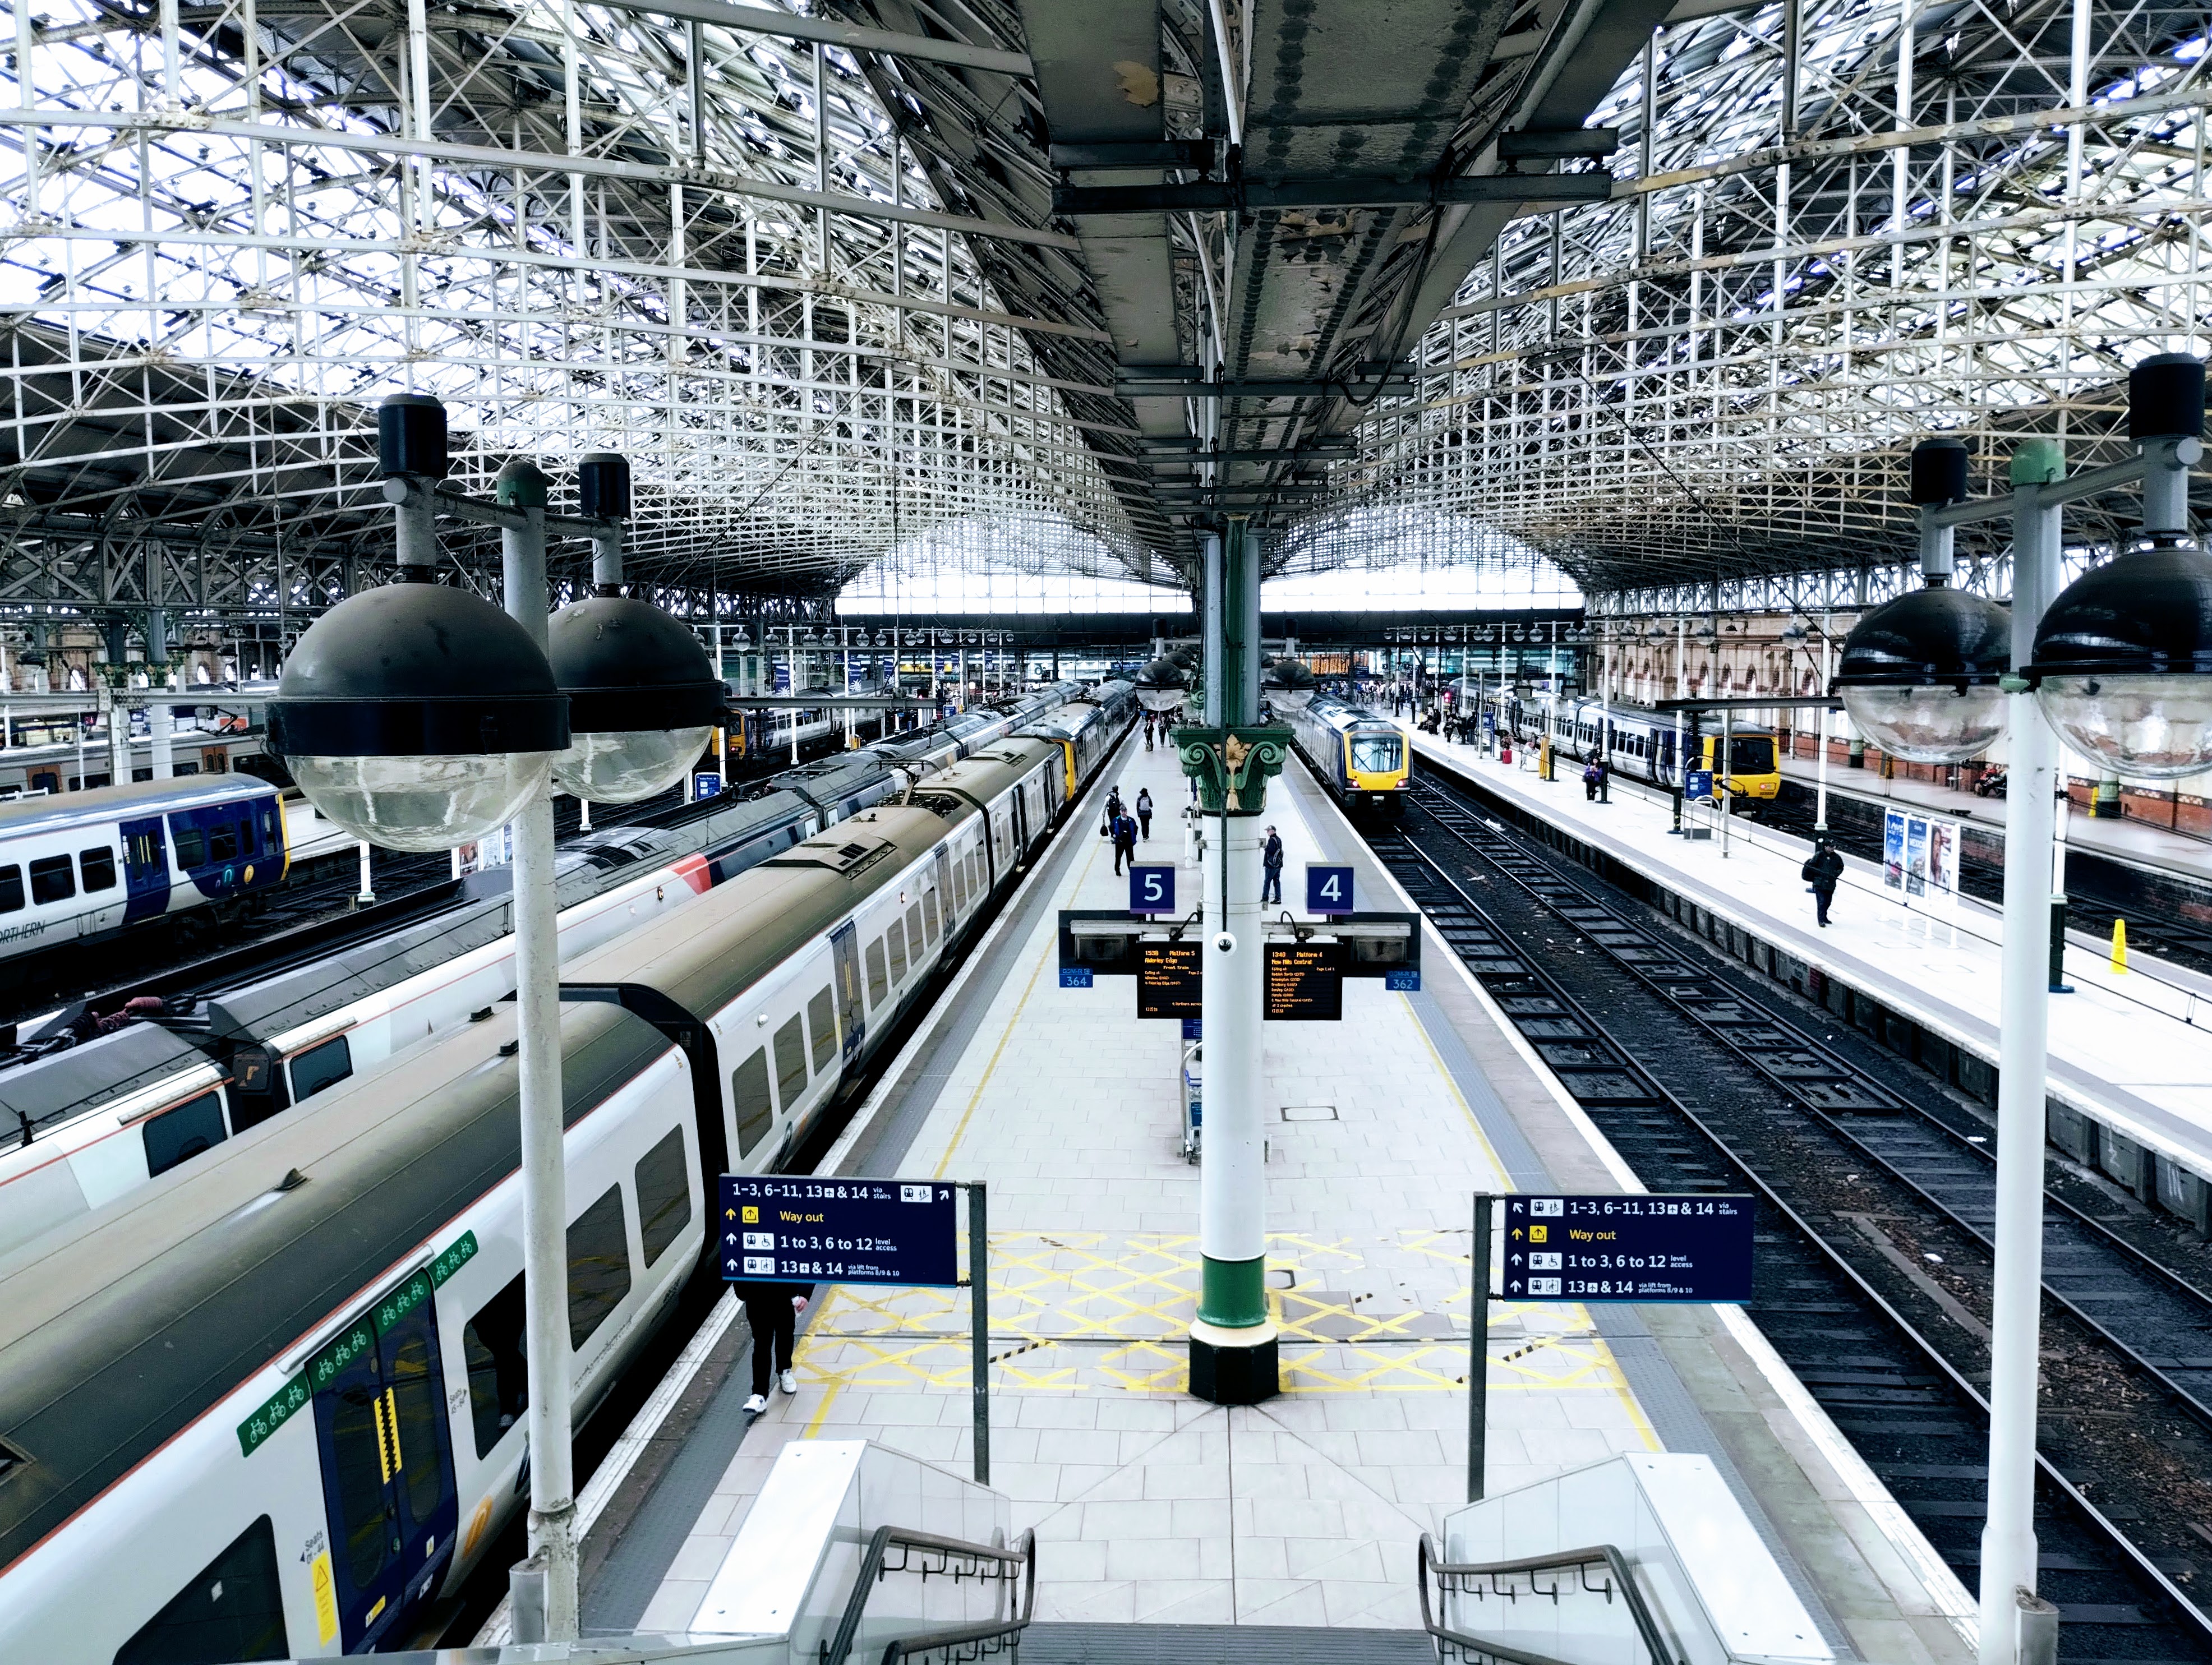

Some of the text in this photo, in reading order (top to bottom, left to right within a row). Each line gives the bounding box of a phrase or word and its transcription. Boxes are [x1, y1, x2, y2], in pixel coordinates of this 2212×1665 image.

[1144, 874, 1163, 901] 5
[1320, 874, 1342, 902] 4
[1067, 976, 1087, 986] 364
[1393, 979, 1413, 989] 362
[806, 1185, 822, 1198] 13
[837, 1186, 847, 1198] &
[851, 1187, 868, 1199] 14
[1648, 1202, 1665, 1215] 13
[1681, 1202, 1692, 1215] &
[1696, 1203, 1714, 1215] 14
[780, 1211, 824, 1224] Way out
[1570, 1229, 1616, 1242] Way out
[780, 1235, 872, 1250] 1 to 3, 6 to 12
[781, 1261, 843, 1275] 13 & 14
[1569, 1254, 1666, 1269] 1 to 3, 6 to 12
[1568, 1280, 1633, 1293] 13 & 14
